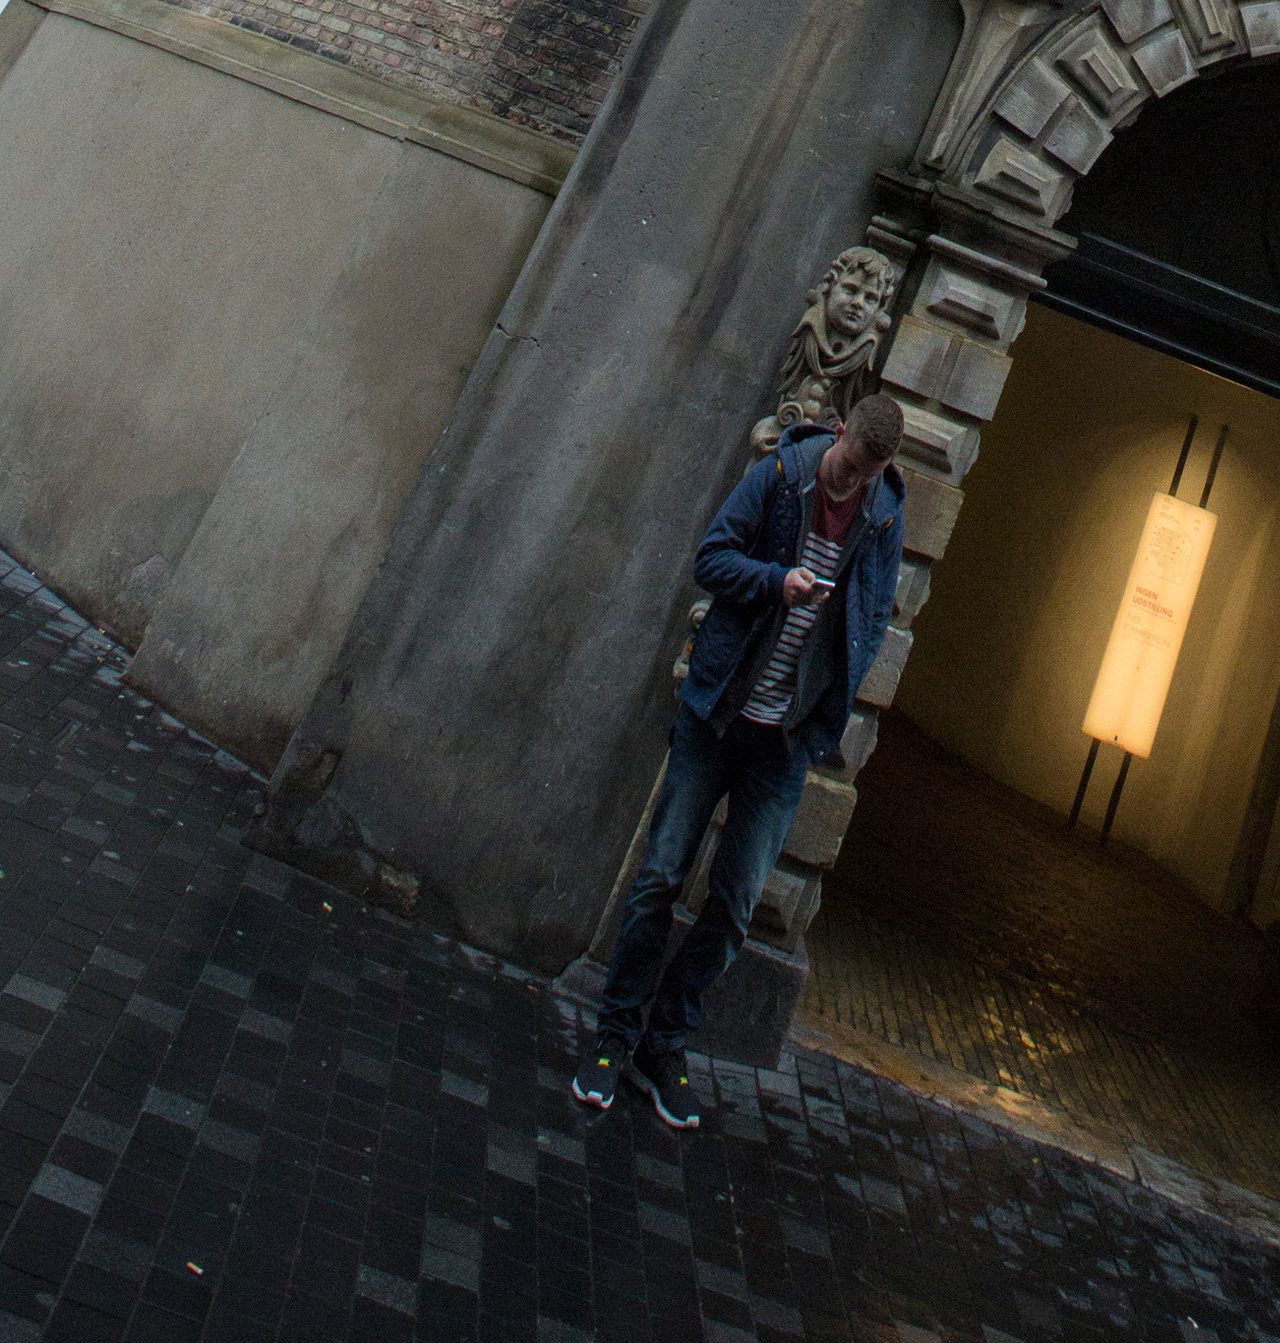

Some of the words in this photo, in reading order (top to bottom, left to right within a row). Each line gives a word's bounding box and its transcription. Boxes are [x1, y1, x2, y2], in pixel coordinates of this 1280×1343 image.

[1135, 585, 1158, 600] INGEN
[1132, 596, 1174, 619] UDSTILLING
[1127, 613, 1141, 624] NO
[1123, 622, 1172, 648] EXHIBITION
